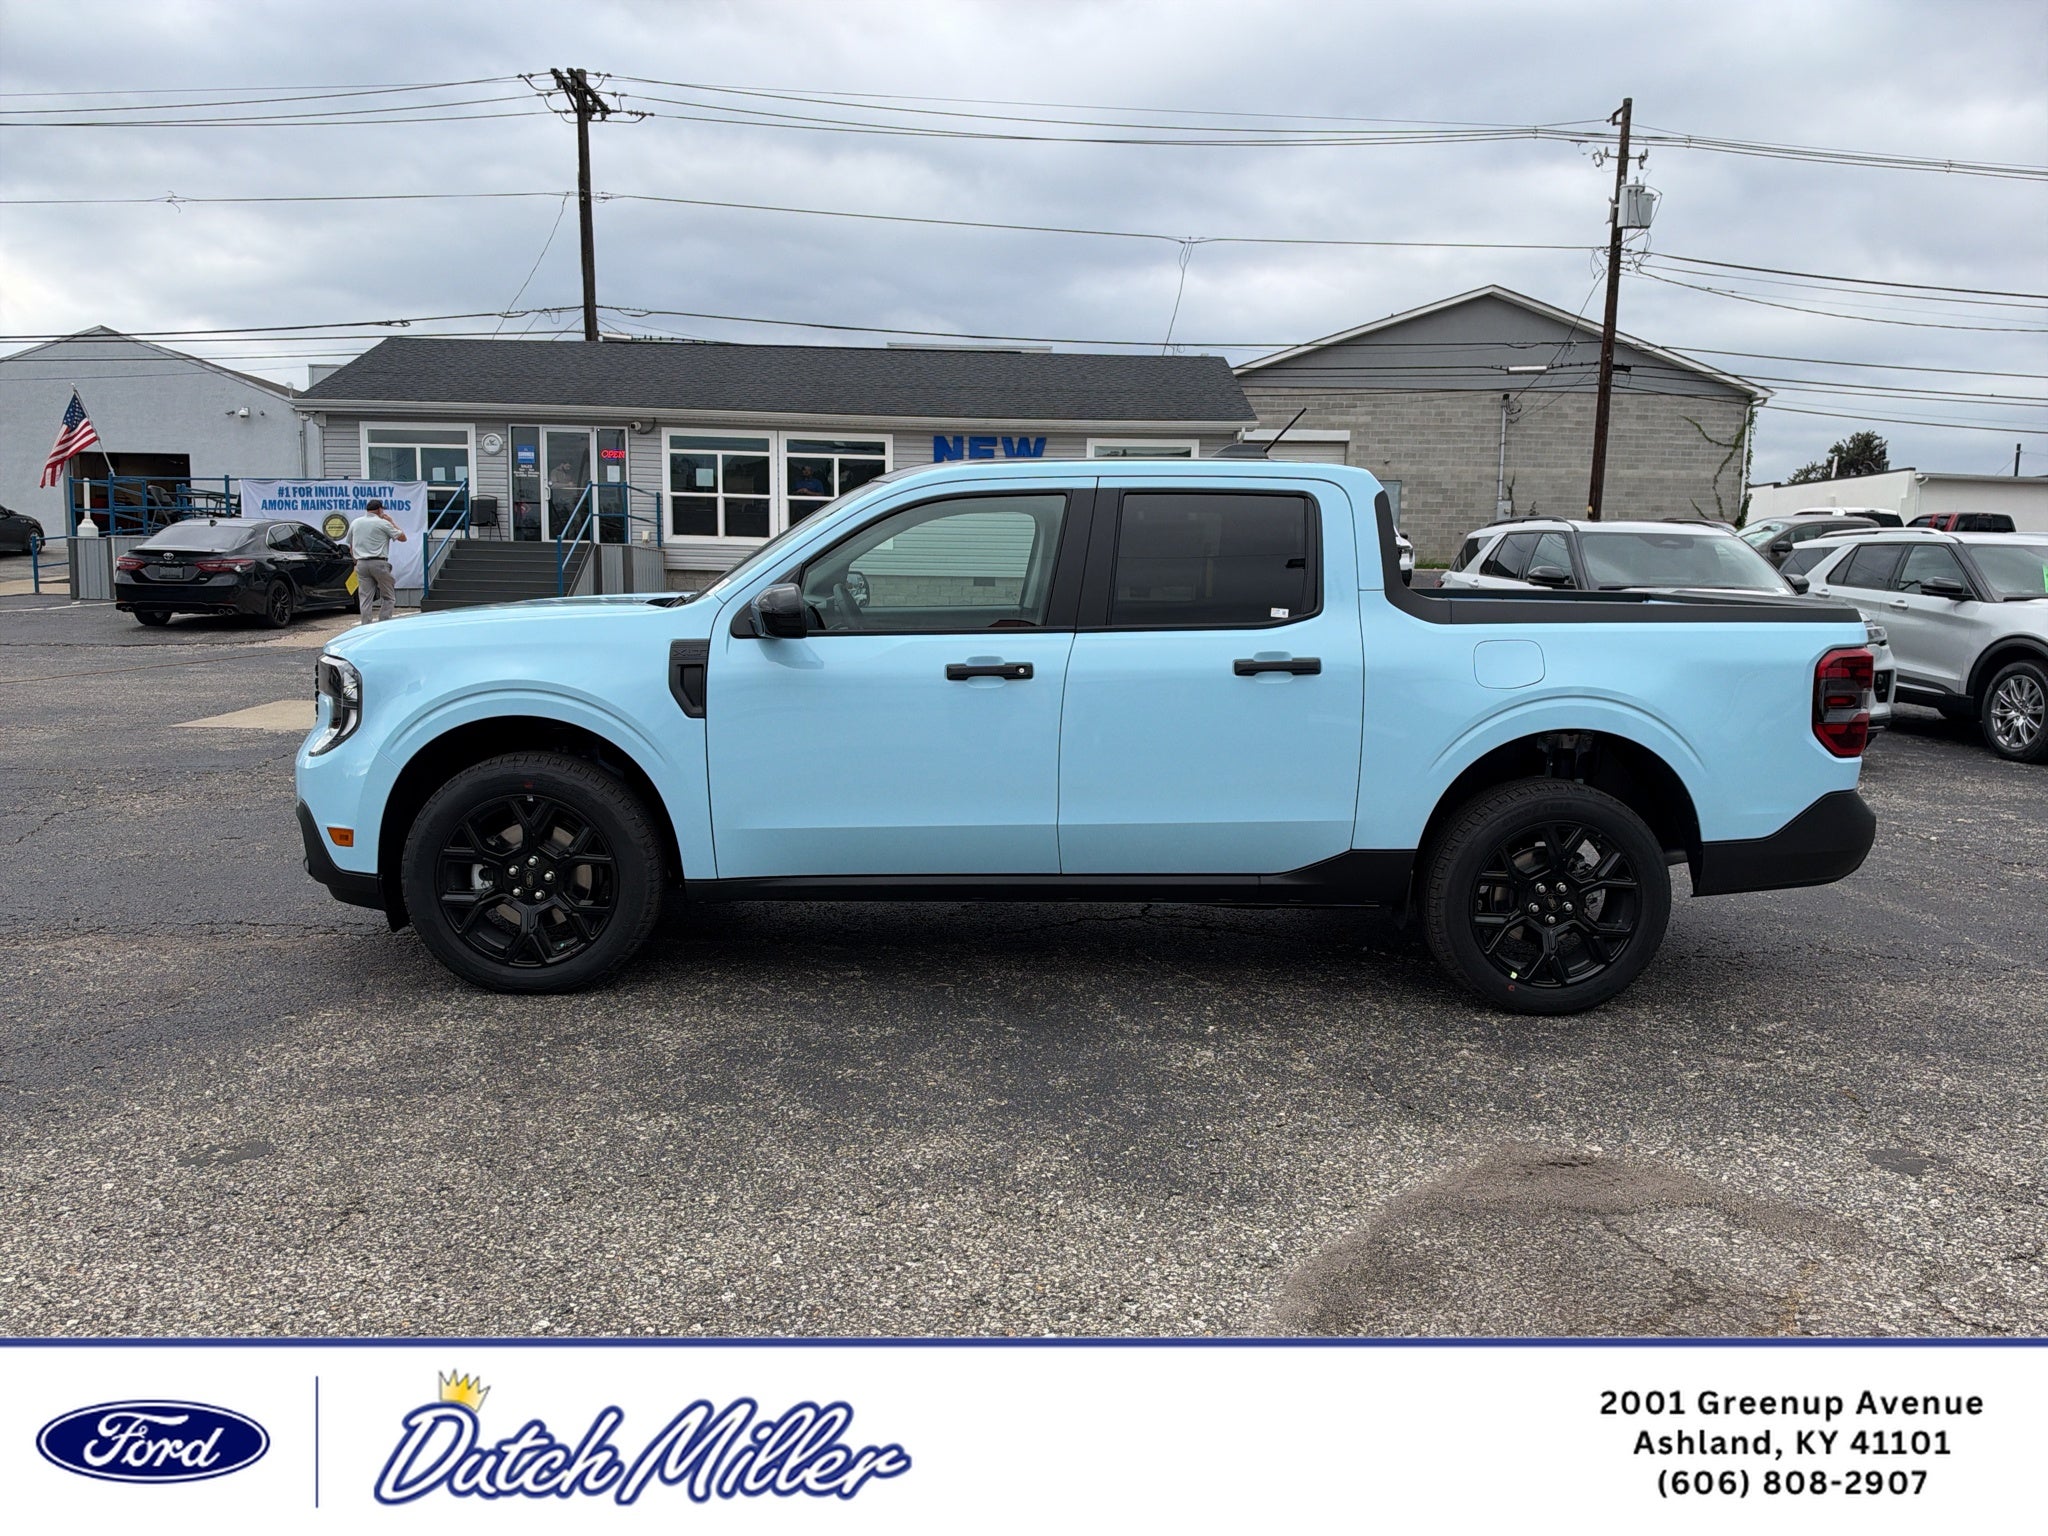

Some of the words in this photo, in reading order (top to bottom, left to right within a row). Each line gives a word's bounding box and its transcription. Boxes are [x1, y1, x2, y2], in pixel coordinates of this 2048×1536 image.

[601, 449, 625, 459] OPEN
[933, 435, 1047, 463] NEW
[278, 486, 290, 498] #1
[292, 486, 312, 498] FOR
[314, 486, 350, 498] INITIAL
[352, 486, 395, 499] QUALITY
[261, 499, 298, 511] AMONG
[300, 499, 366, 511] MAINSTREAM
[375, 500, 411, 511] ANDS
